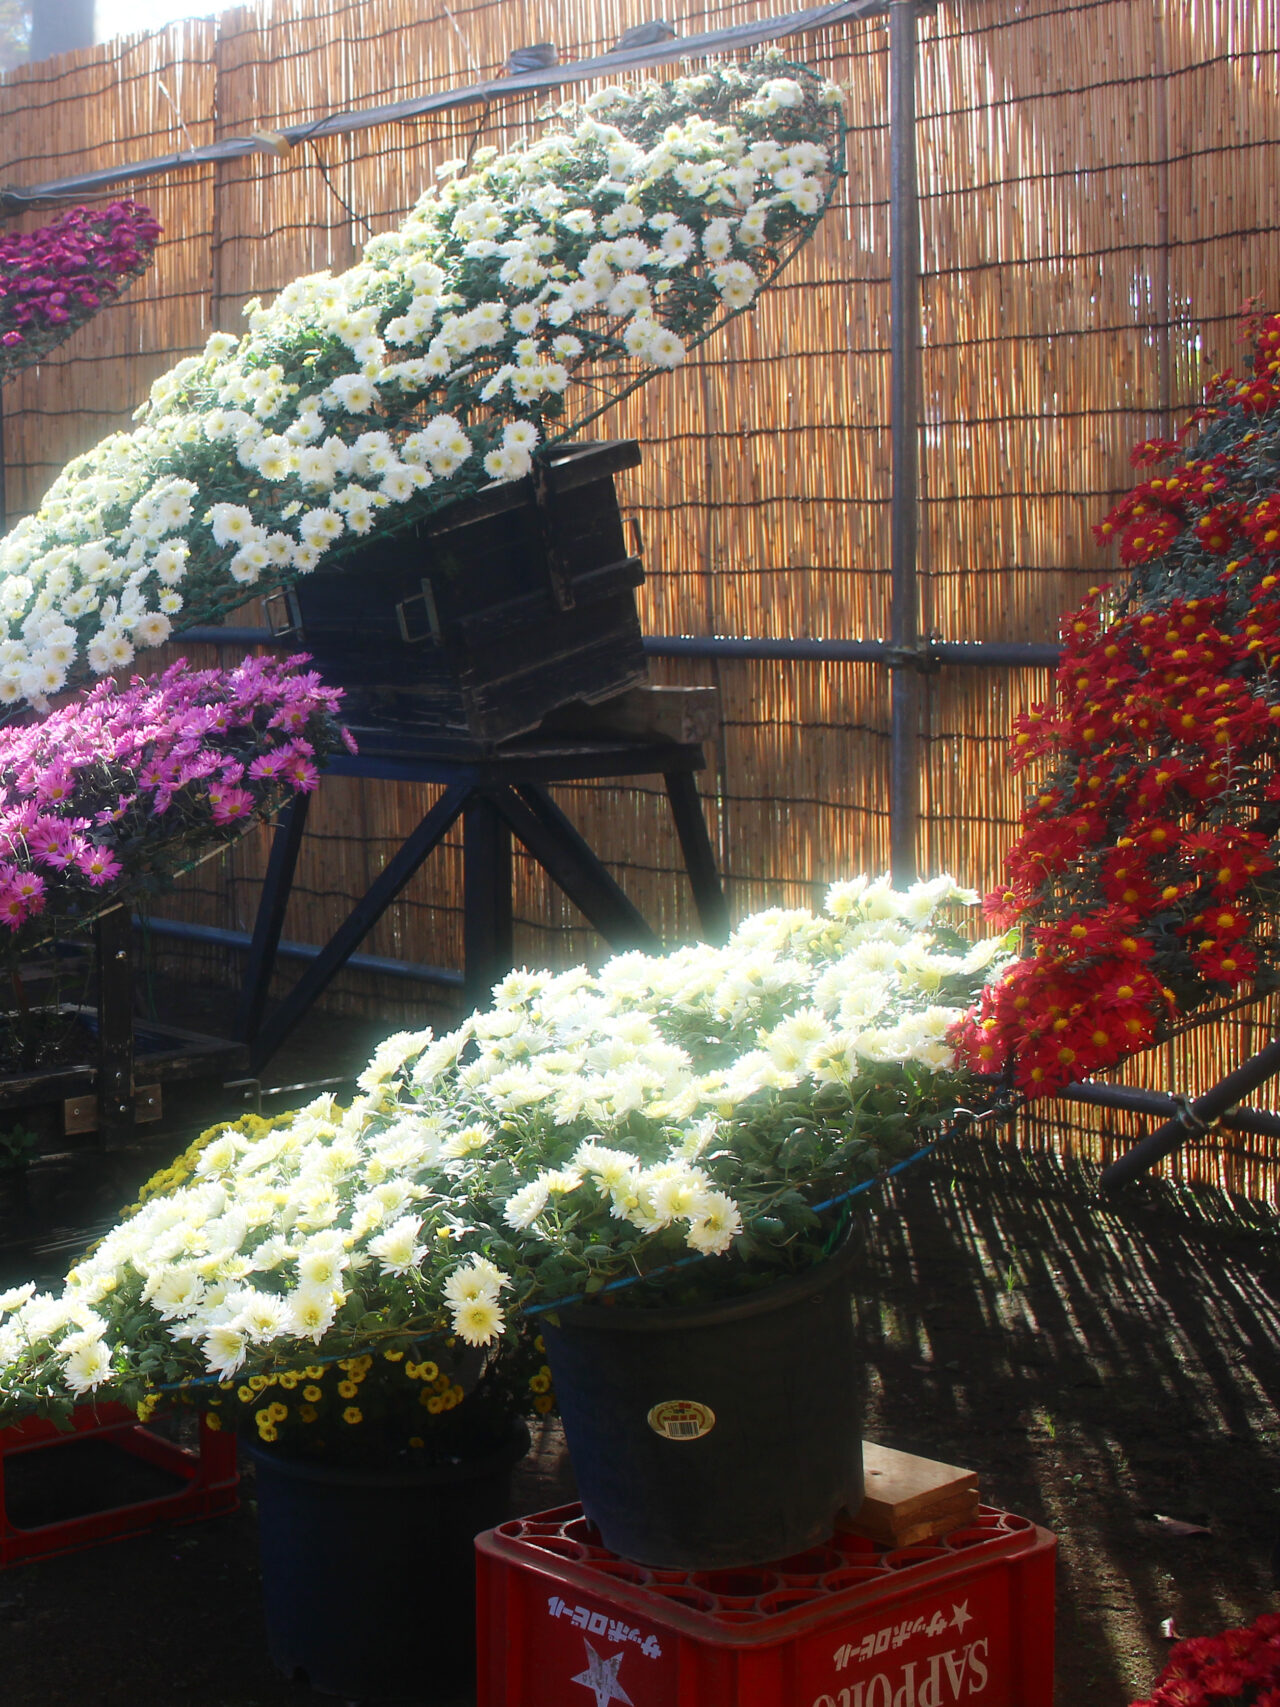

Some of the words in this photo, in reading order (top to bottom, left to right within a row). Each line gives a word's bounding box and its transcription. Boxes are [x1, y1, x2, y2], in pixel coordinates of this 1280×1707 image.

[548, 1596, 662, 1659] サッポロビール
[833, 1610, 947, 1671] サッポロビール
[812, 1637, 988, 1707] SAPPO
